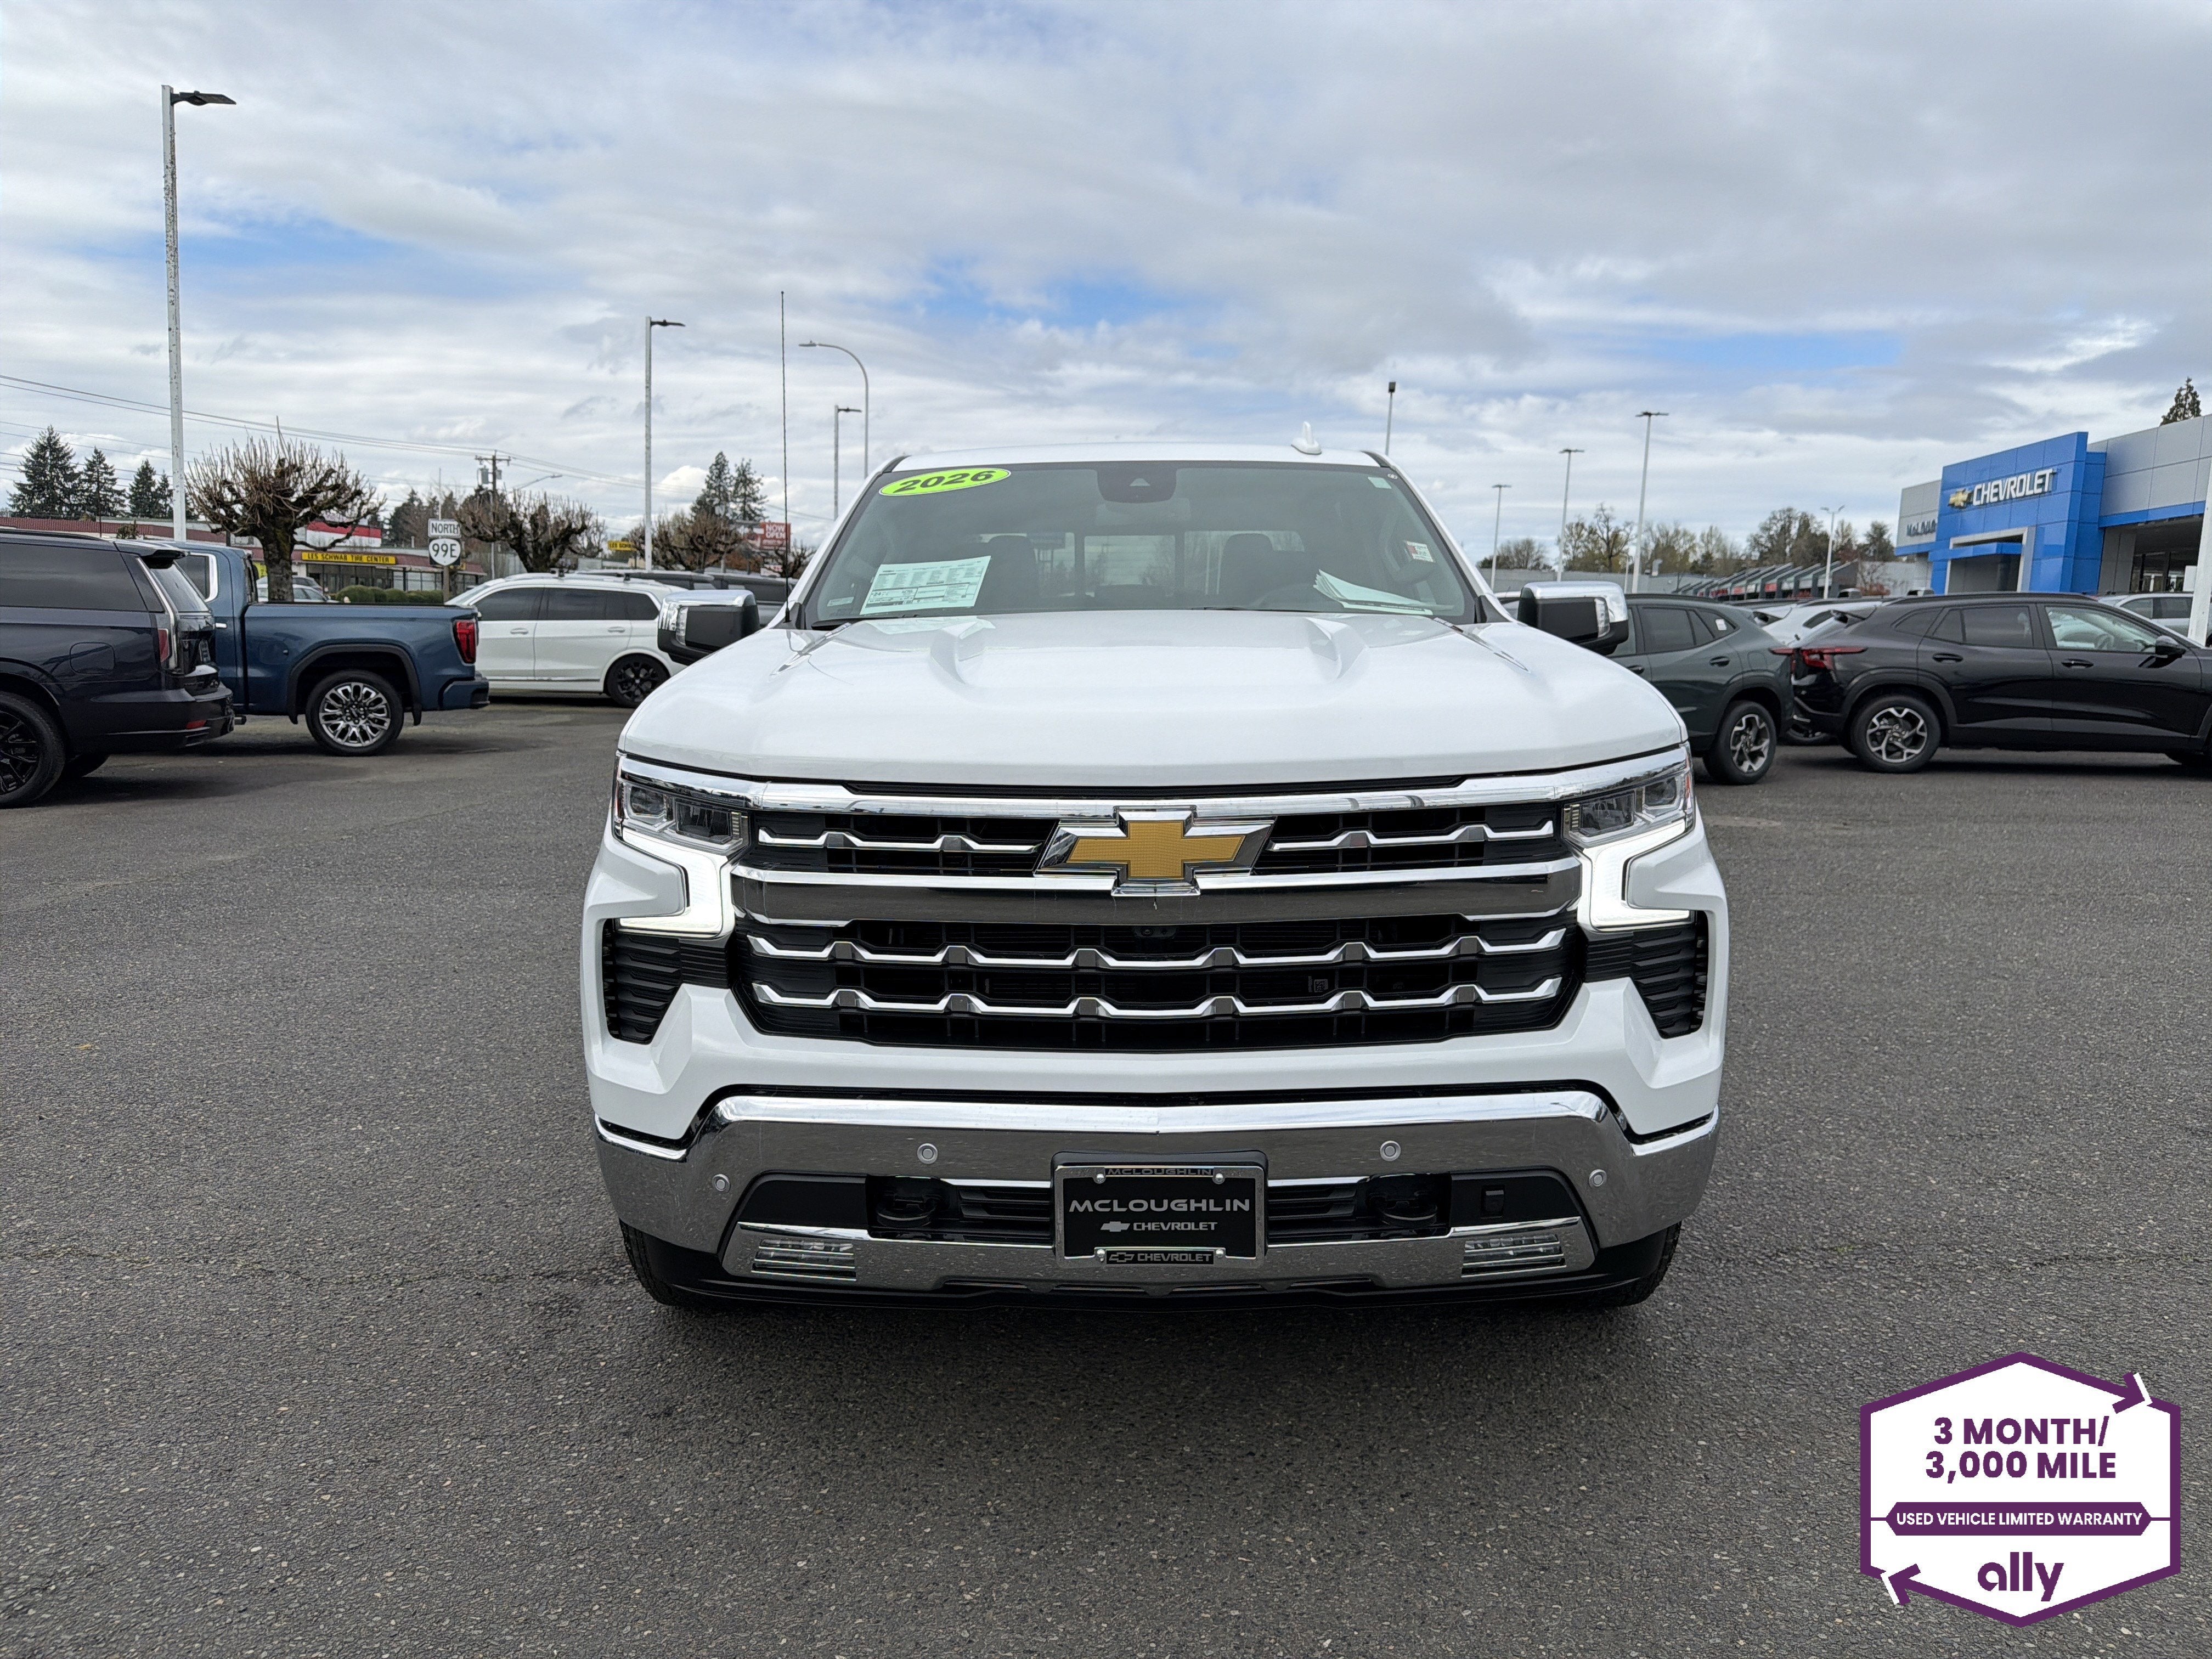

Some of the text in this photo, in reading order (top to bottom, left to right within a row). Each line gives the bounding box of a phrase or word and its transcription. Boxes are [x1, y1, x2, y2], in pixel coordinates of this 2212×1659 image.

[893, 470, 996, 493] 2026
[1972, 468, 2053, 506] CHEVROLET
[431, 522, 460, 534] NORTH
[432, 543, 457, 558] 99E
[1069, 1199, 1250, 1212] MCLOUGHLIN
[1133, 1222, 1218, 1231] CHEVROLET
[1137, 1252, 1212, 1262] CHEVROLET
